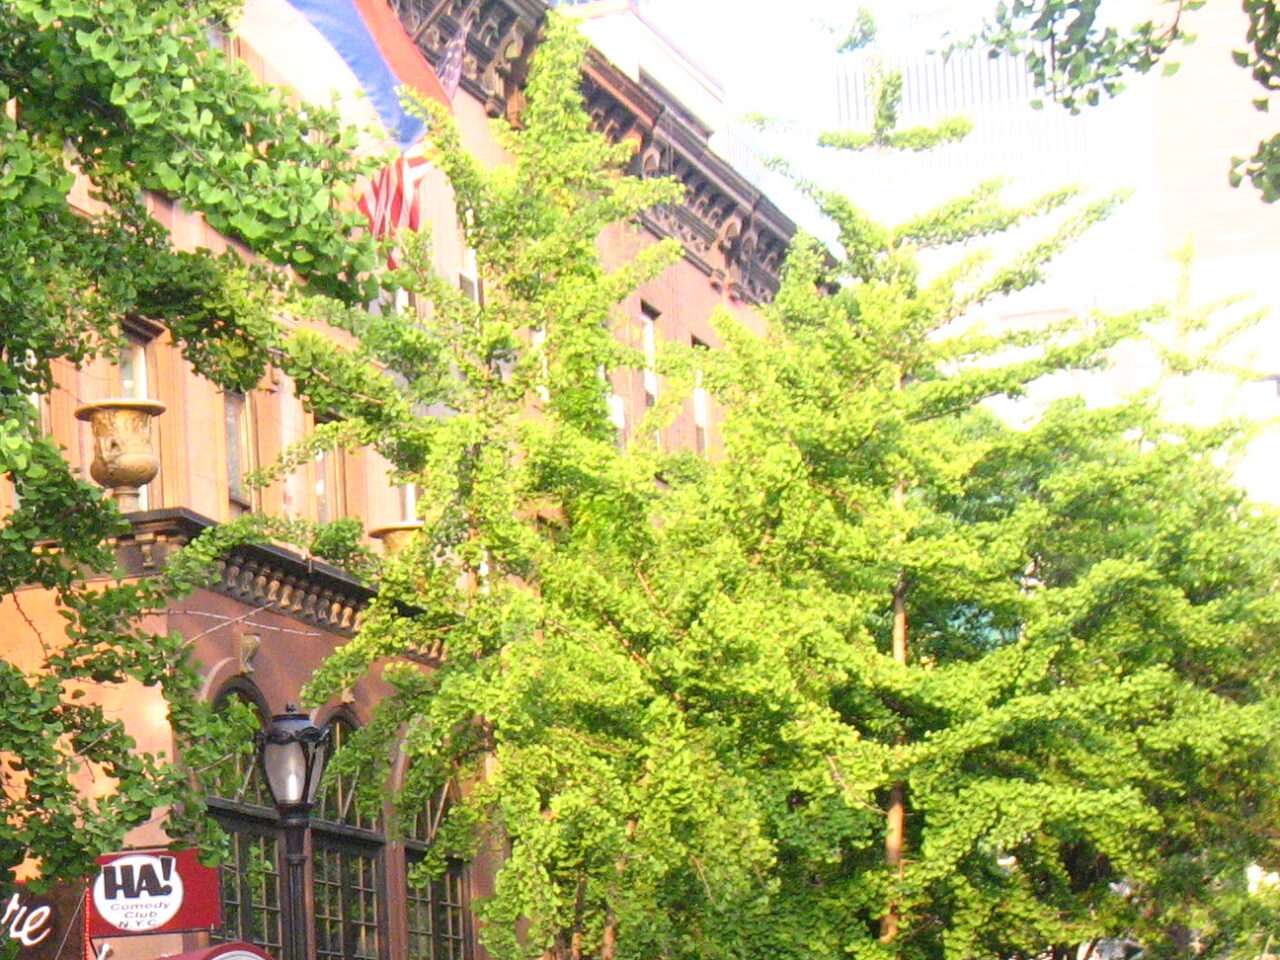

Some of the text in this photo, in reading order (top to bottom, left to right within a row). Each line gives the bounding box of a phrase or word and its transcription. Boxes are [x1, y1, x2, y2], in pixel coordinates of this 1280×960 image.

[101, 855, 176, 901] HA!
[110, 900, 171, 914] Comedy
[124, 910, 158, 919] Club
